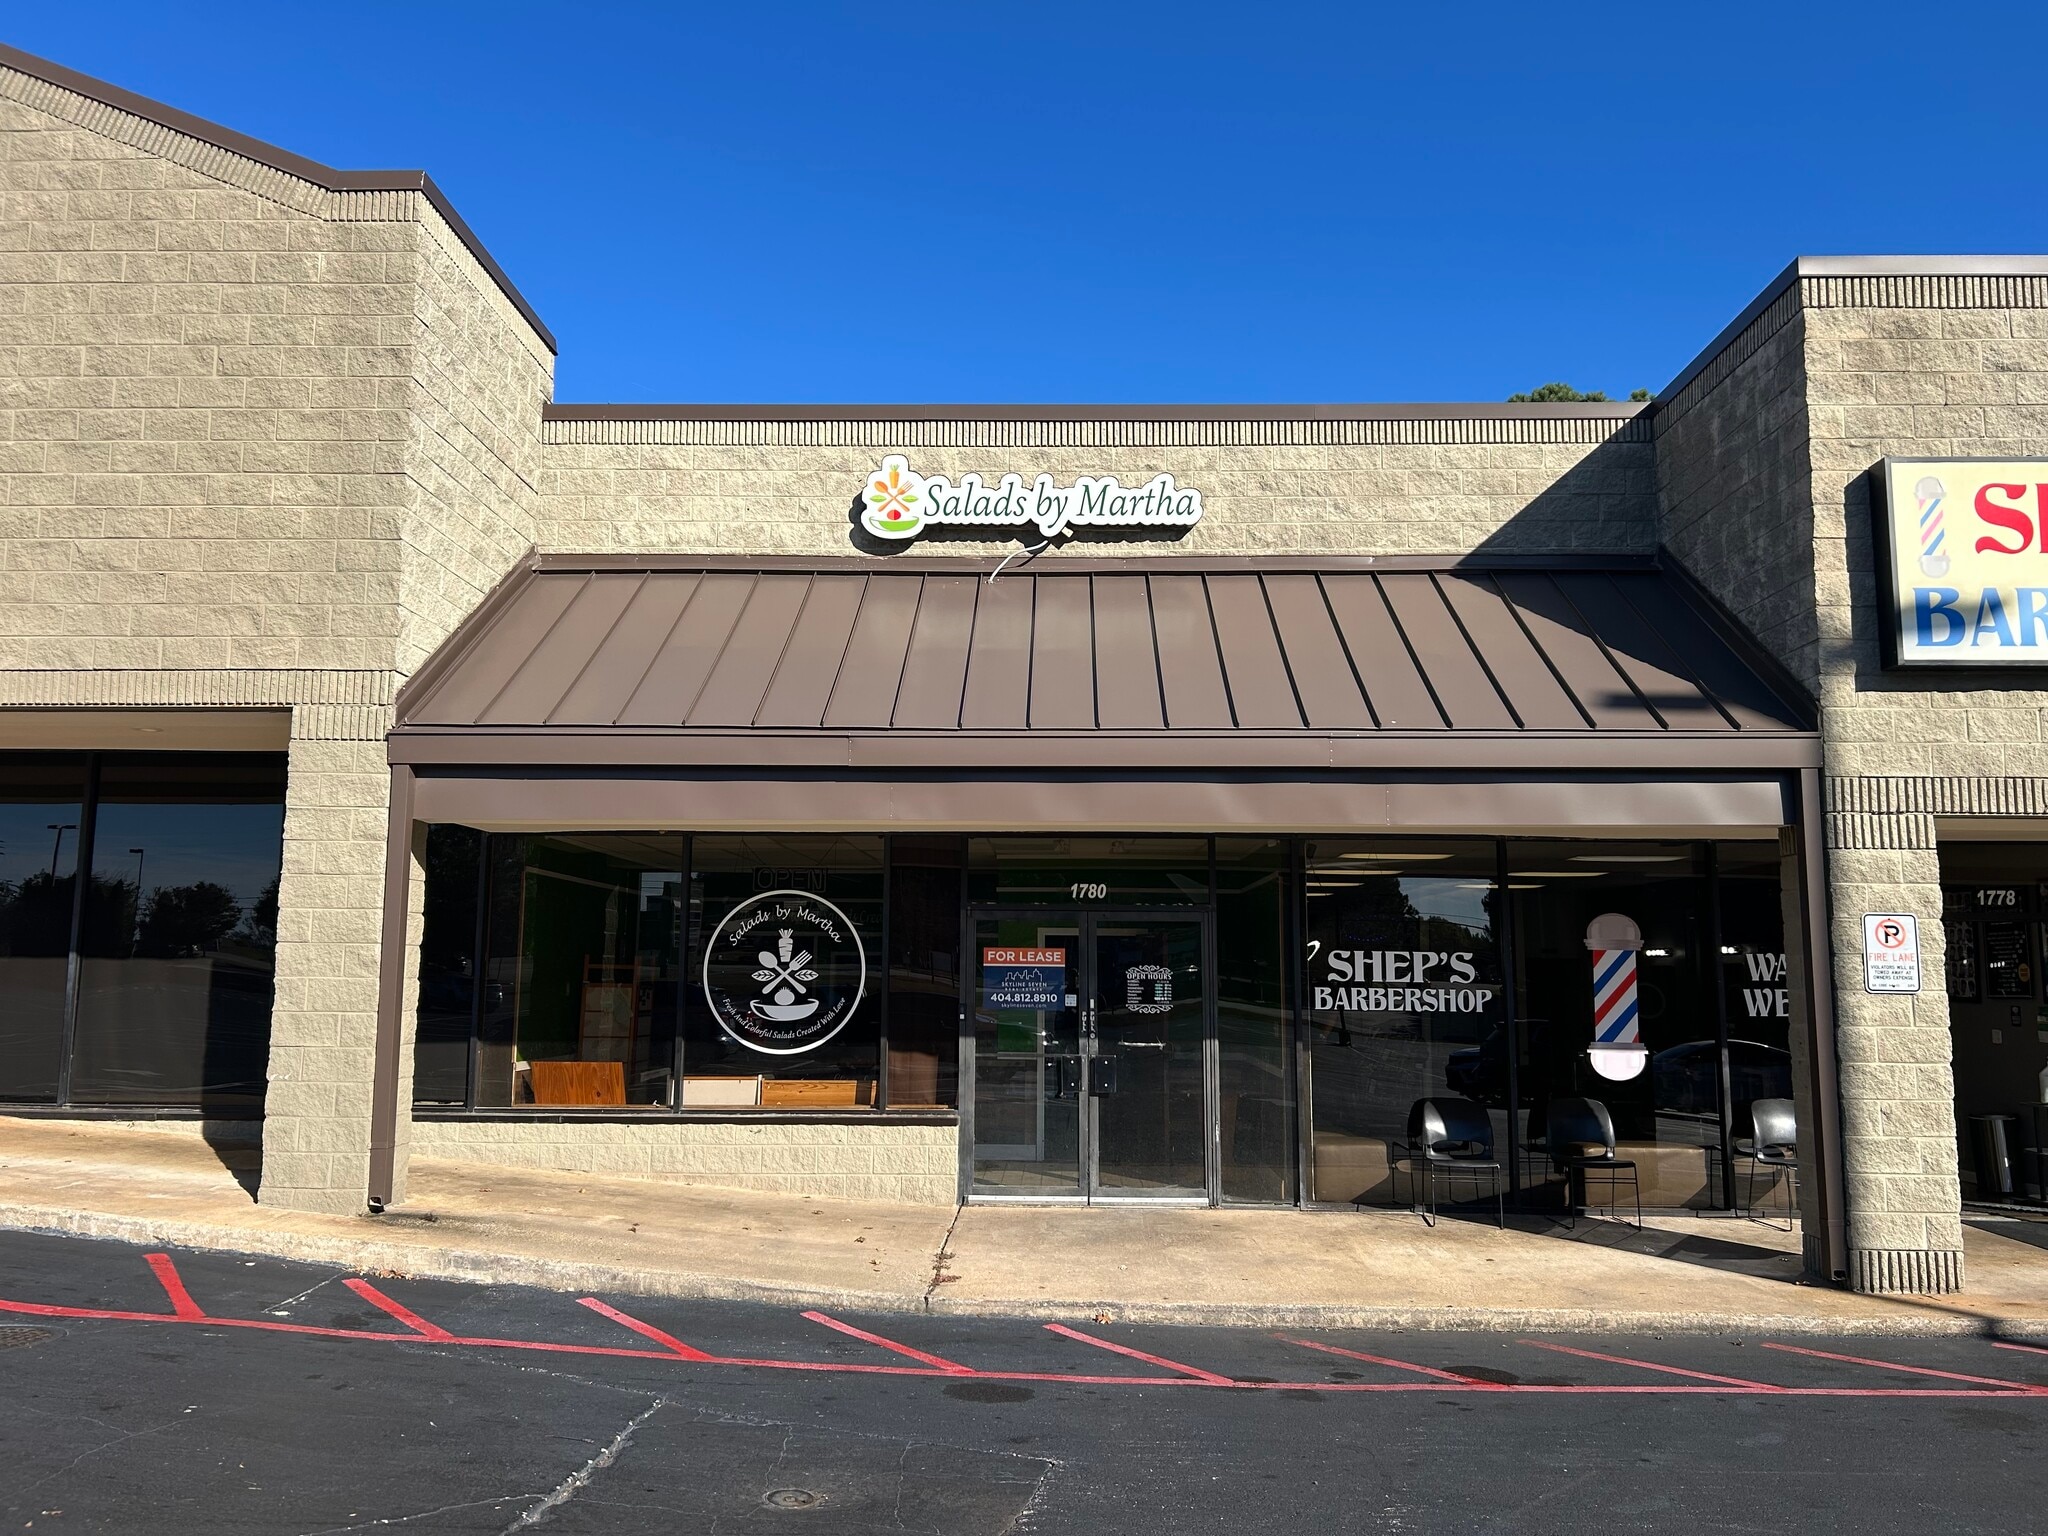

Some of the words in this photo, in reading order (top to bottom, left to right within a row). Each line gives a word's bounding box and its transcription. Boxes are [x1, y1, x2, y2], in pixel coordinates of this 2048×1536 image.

[924, 481, 1027, 518] Salads
[1036, 481, 1068, 529] by
[1077, 481, 1195, 518] Martha
[1070, 883, 1107, 899] 1780
[1977, 889, 2016, 906] 1778
[729, 910, 771, 946] Salads
[776, 904, 791, 919] by
[797, 906, 842, 943] Martha
[987, 951, 1015, 962] FOR
[1019, 951, 1062, 962] LEASE
[1868, 952, 1888, 962] FIRE
[1892, 952, 1916, 962] LANE
[1327, 949, 1476, 985] SHEP'S
[1126, 972, 1146, 980] OPEN
[1147, 972, 1172, 980] HOURS
[990, 993, 1058, 1003] 404.812.8910
[1314, 987, 1493, 1014] BARBERSHOP
[722, 998, 736, 1015] Fresh
[734, 1012, 748, 1026] And
[745, 1020, 772, 1038] Colorful
[772, 1029, 795, 1039] Salads
[796, 1021, 822, 1037] Created
[820, 1011, 836, 1024] With
[834, 997, 846, 1013] Love
